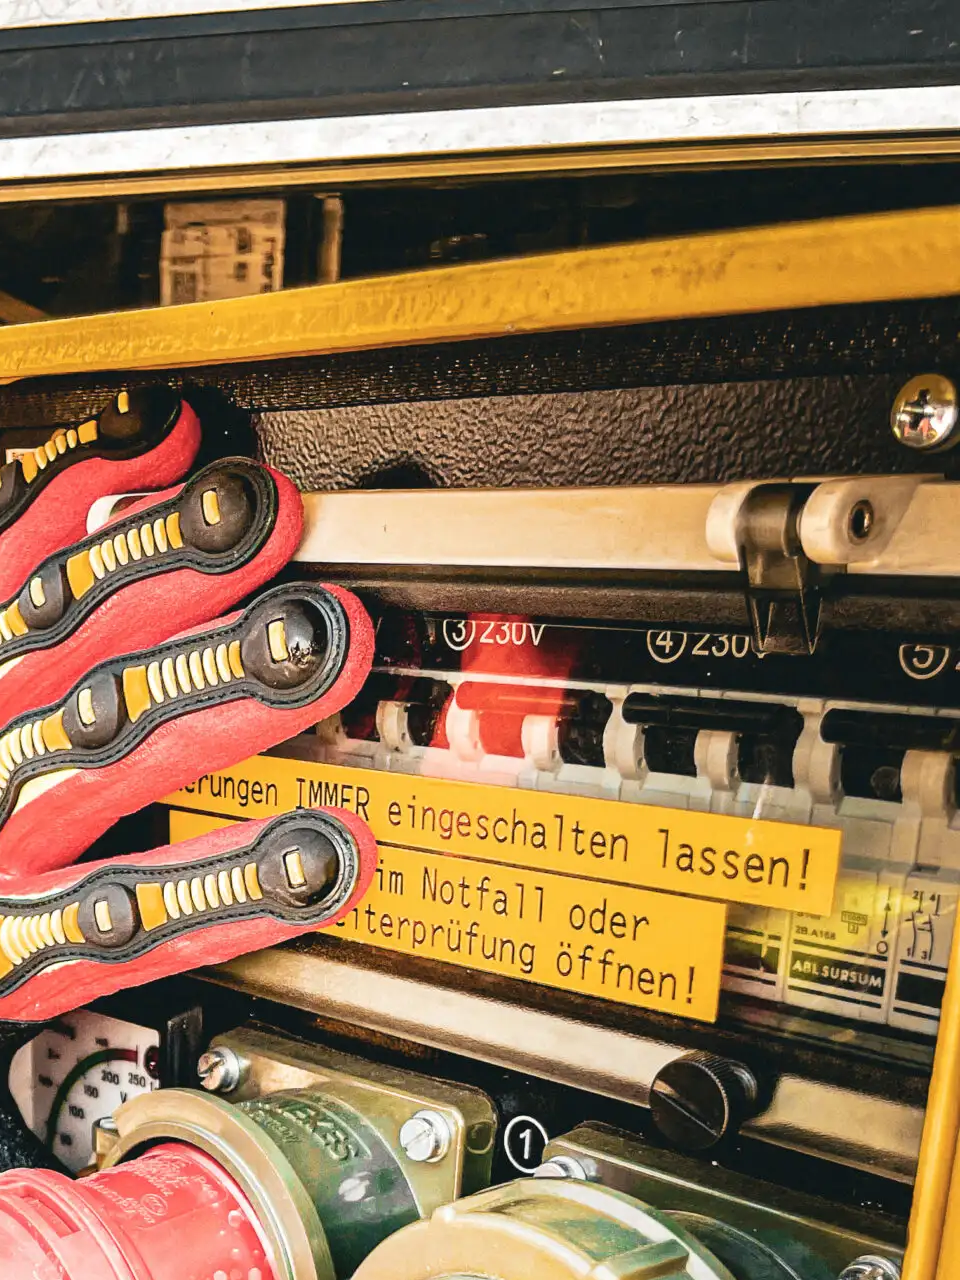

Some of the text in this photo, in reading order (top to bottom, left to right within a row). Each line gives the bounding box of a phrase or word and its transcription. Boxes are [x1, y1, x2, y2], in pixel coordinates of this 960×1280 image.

[480, 621, 547, 647] 230V
[388, 795, 628, 862] eingeschalten
[658, 828, 810, 890] lassen!
[422, 866, 544, 922] Notfall
[569, 898, 650, 941] oder
[556, 940, 696, 1004] öffnen!
